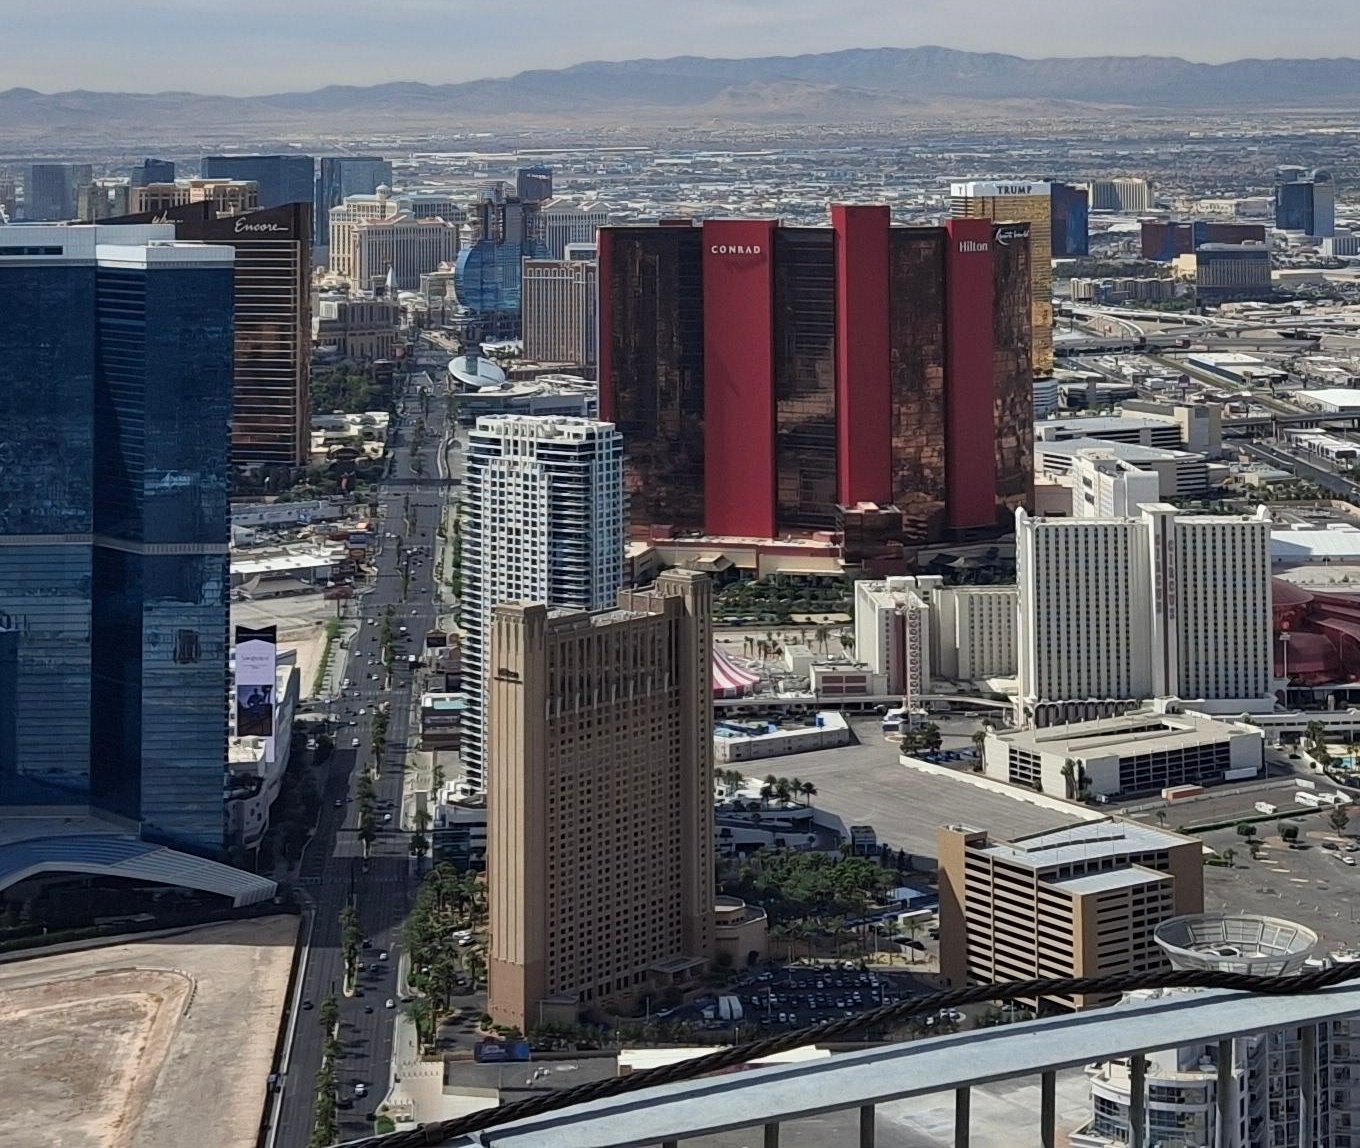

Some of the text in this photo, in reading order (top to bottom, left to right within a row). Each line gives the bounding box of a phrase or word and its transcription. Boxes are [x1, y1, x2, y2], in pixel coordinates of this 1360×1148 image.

[997, 185, 1032, 195] TRUMP
[234, 217, 289, 233] Encore
[711, 245, 761, 254] CONRAD
[959, 241, 988, 252] Hilton
